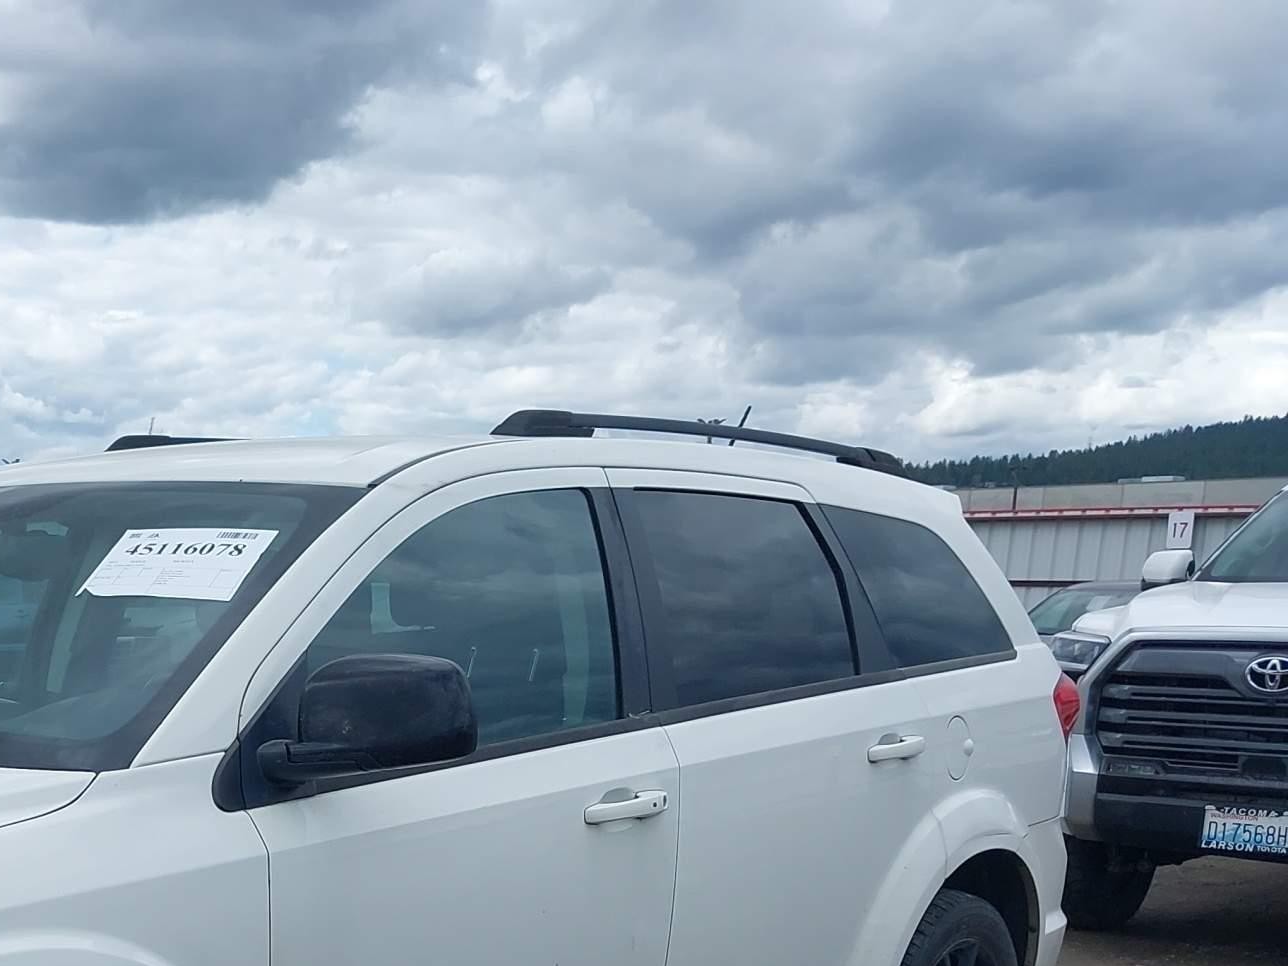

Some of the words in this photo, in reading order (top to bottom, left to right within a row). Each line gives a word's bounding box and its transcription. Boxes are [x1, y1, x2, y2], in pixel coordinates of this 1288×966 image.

[1172, 522, 1189, 539] 17
[126, 543, 247, 556] 45116078
[1223, 807, 1275, 817] TACOMA
[1201, 840, 1254, 852] LARSON
[1257, 845, 1286, 853] TOYOTA
